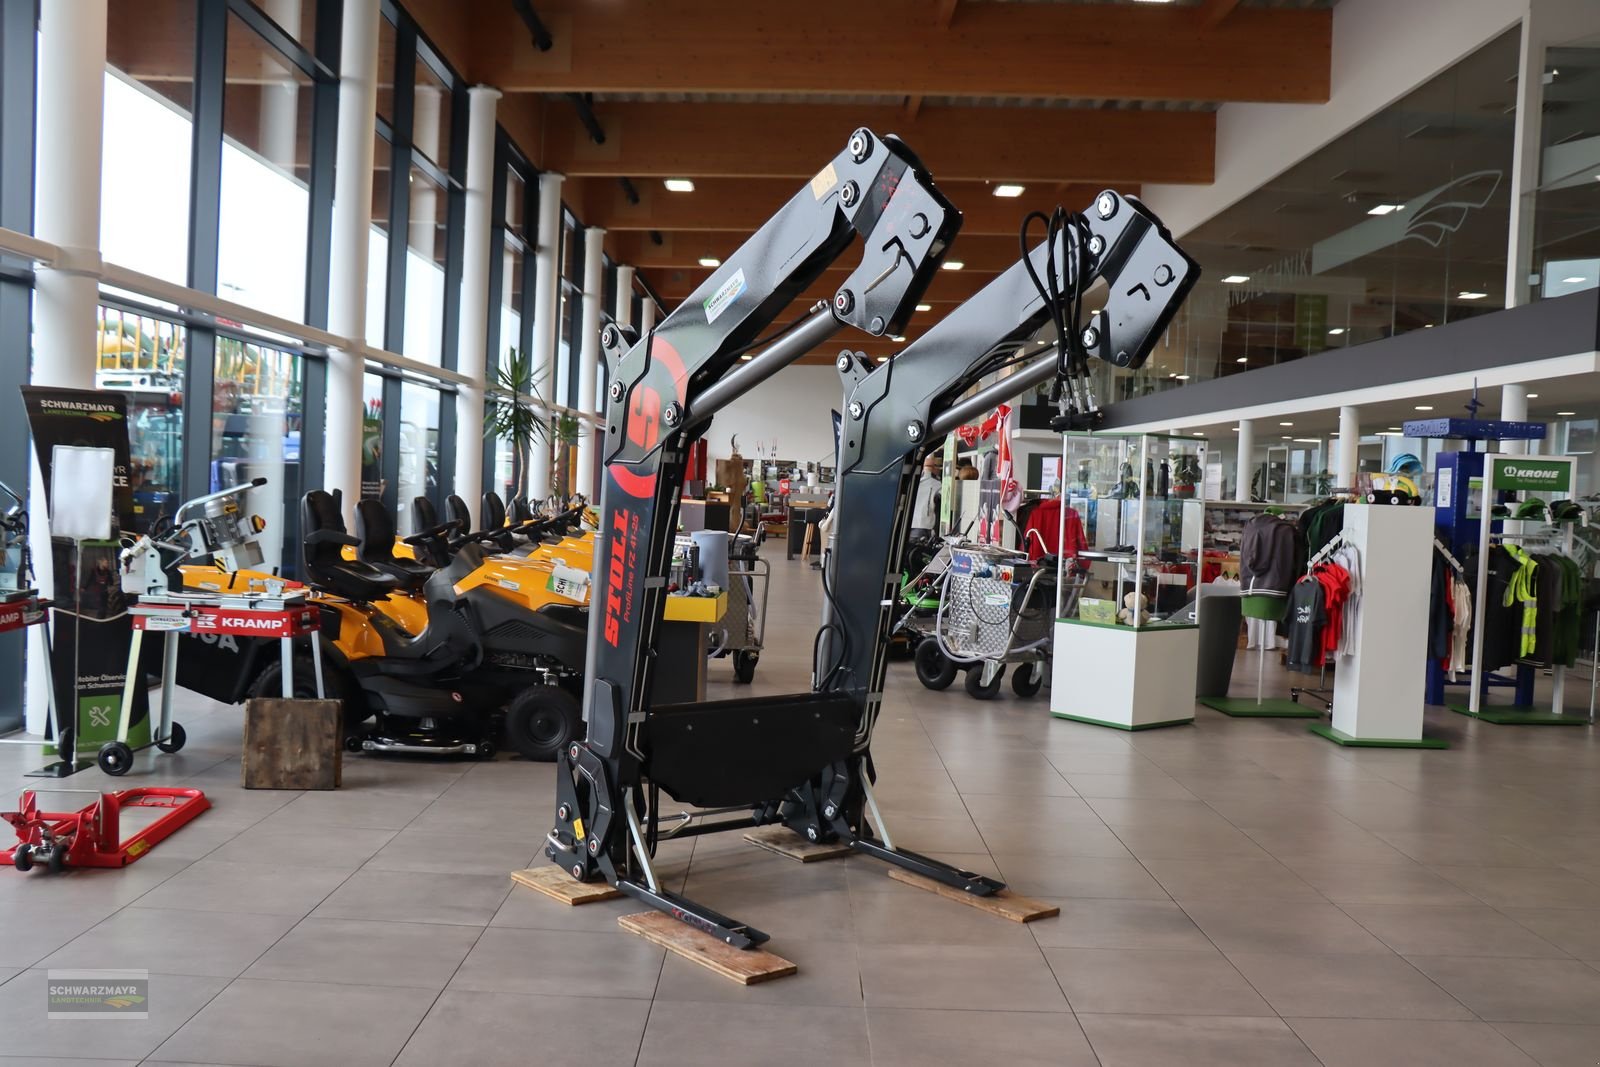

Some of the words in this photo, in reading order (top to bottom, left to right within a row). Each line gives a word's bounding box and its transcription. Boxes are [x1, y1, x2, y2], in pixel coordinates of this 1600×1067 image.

[40, 399, 116, 412] SCHWARZMAYR
[1516, 469, 1560, 479] KRONE
[630, 512, 640, 548] 41-25
[628, 551, 637, 569] FZ
[604, 507, 629, 648] STOLL
[221, 616, 283, 630] KRAMP
